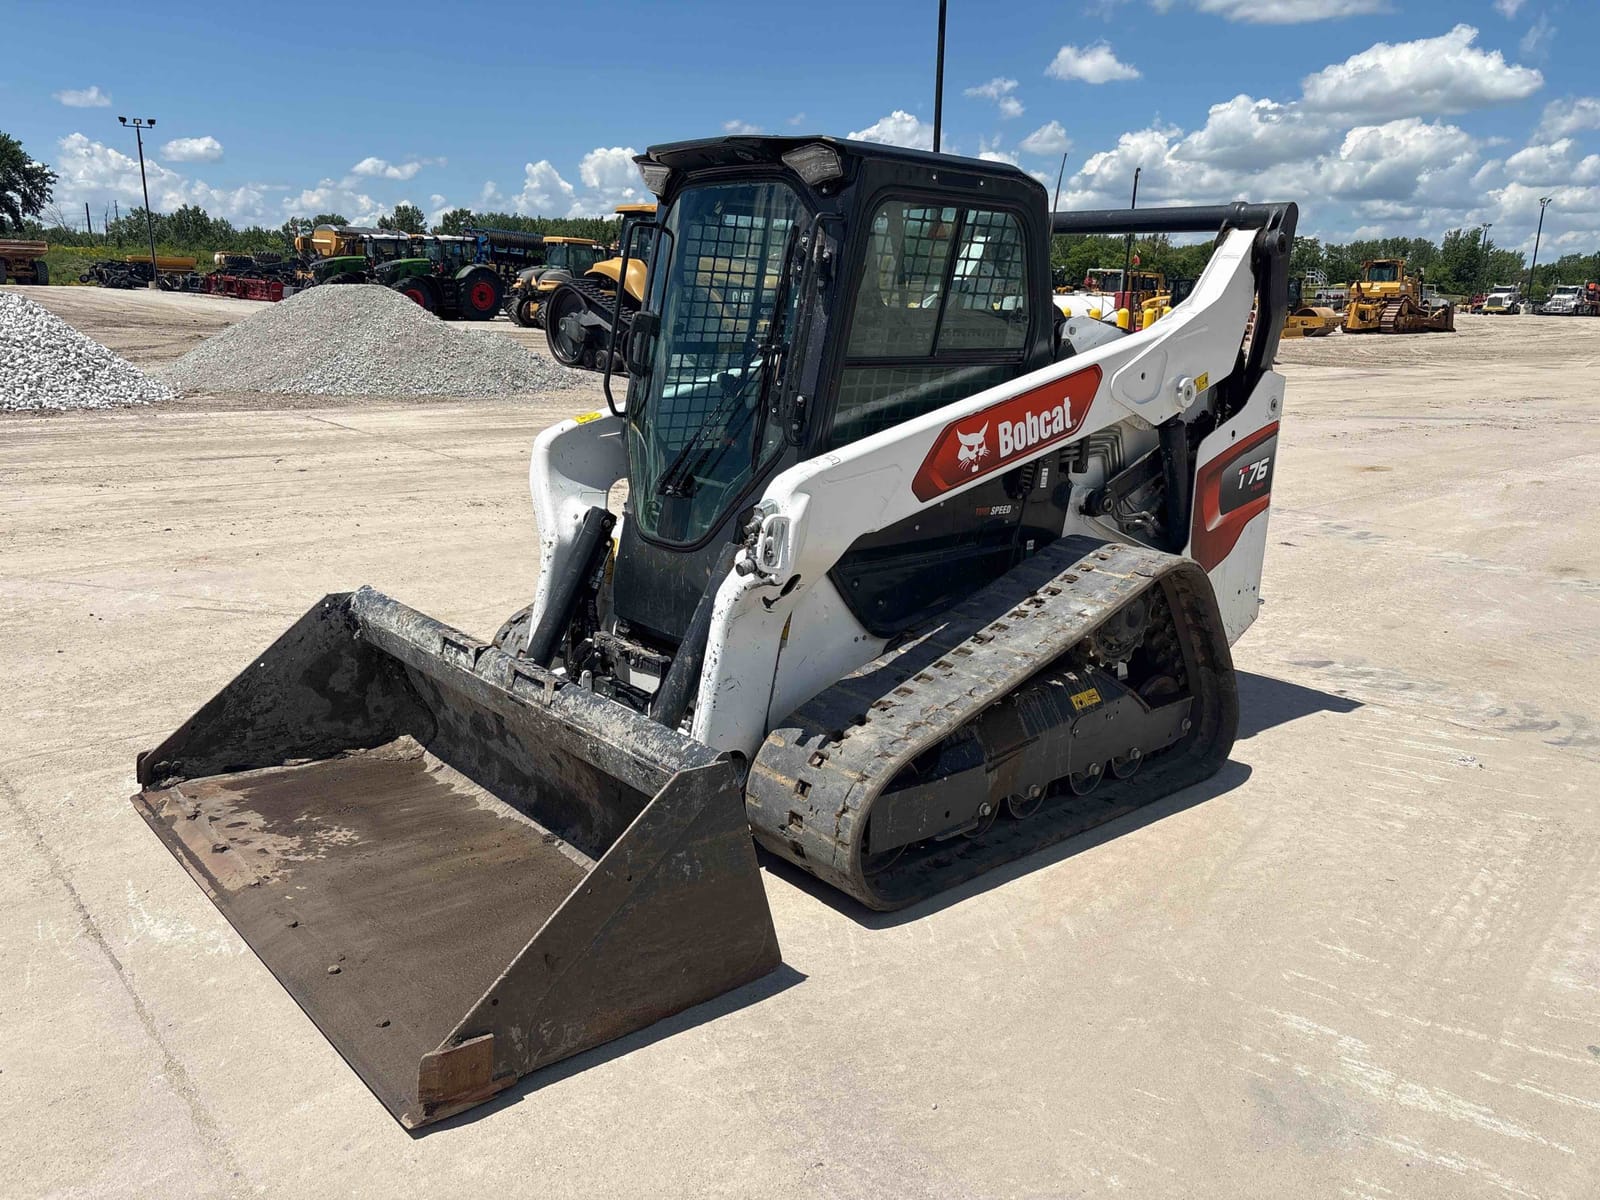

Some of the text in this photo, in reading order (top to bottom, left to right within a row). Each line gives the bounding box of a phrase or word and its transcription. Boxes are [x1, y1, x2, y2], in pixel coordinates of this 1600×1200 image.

[998, 396, 1072, 458] Bobcat
[1239, 457, 1270, 489] T76
[990, 504, 1012, 515] SPEED
